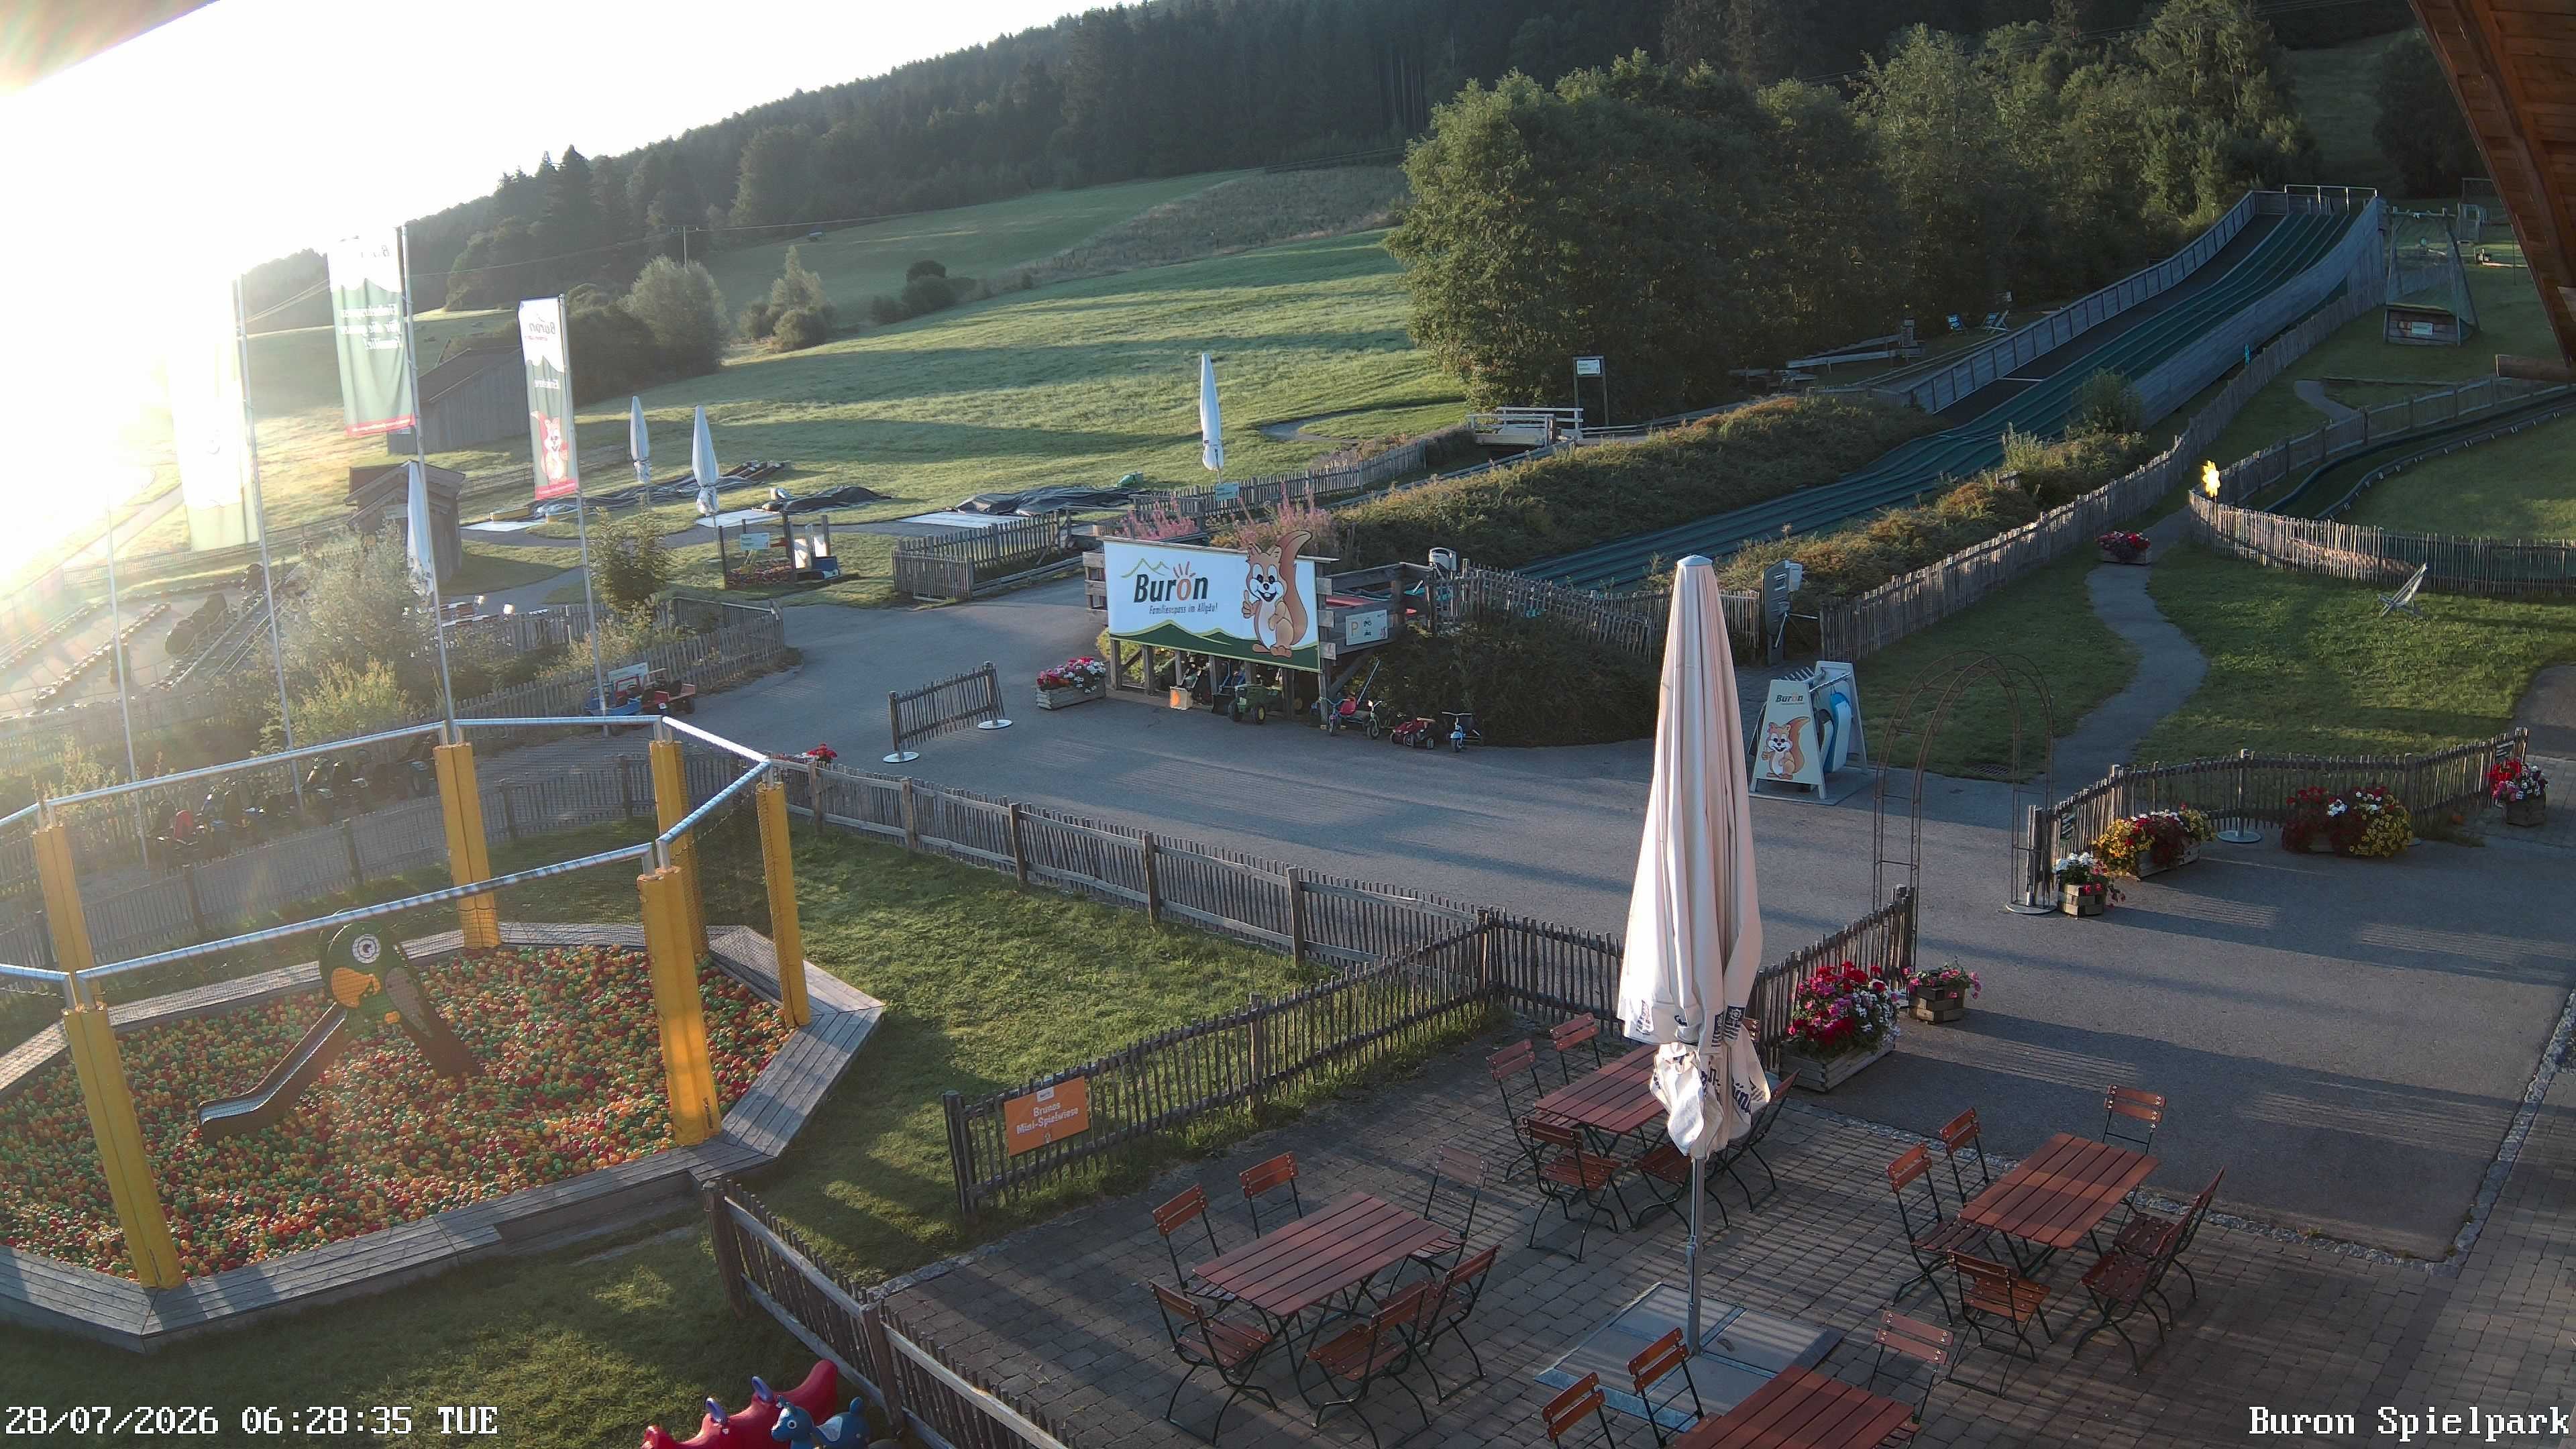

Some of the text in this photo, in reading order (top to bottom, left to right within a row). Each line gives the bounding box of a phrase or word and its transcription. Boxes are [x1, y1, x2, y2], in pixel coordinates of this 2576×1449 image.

[1134, 573, 1209, 603] Buron
[1351, 621, 1358, 637] P
[1775, 694, 1804, 703] Buron
